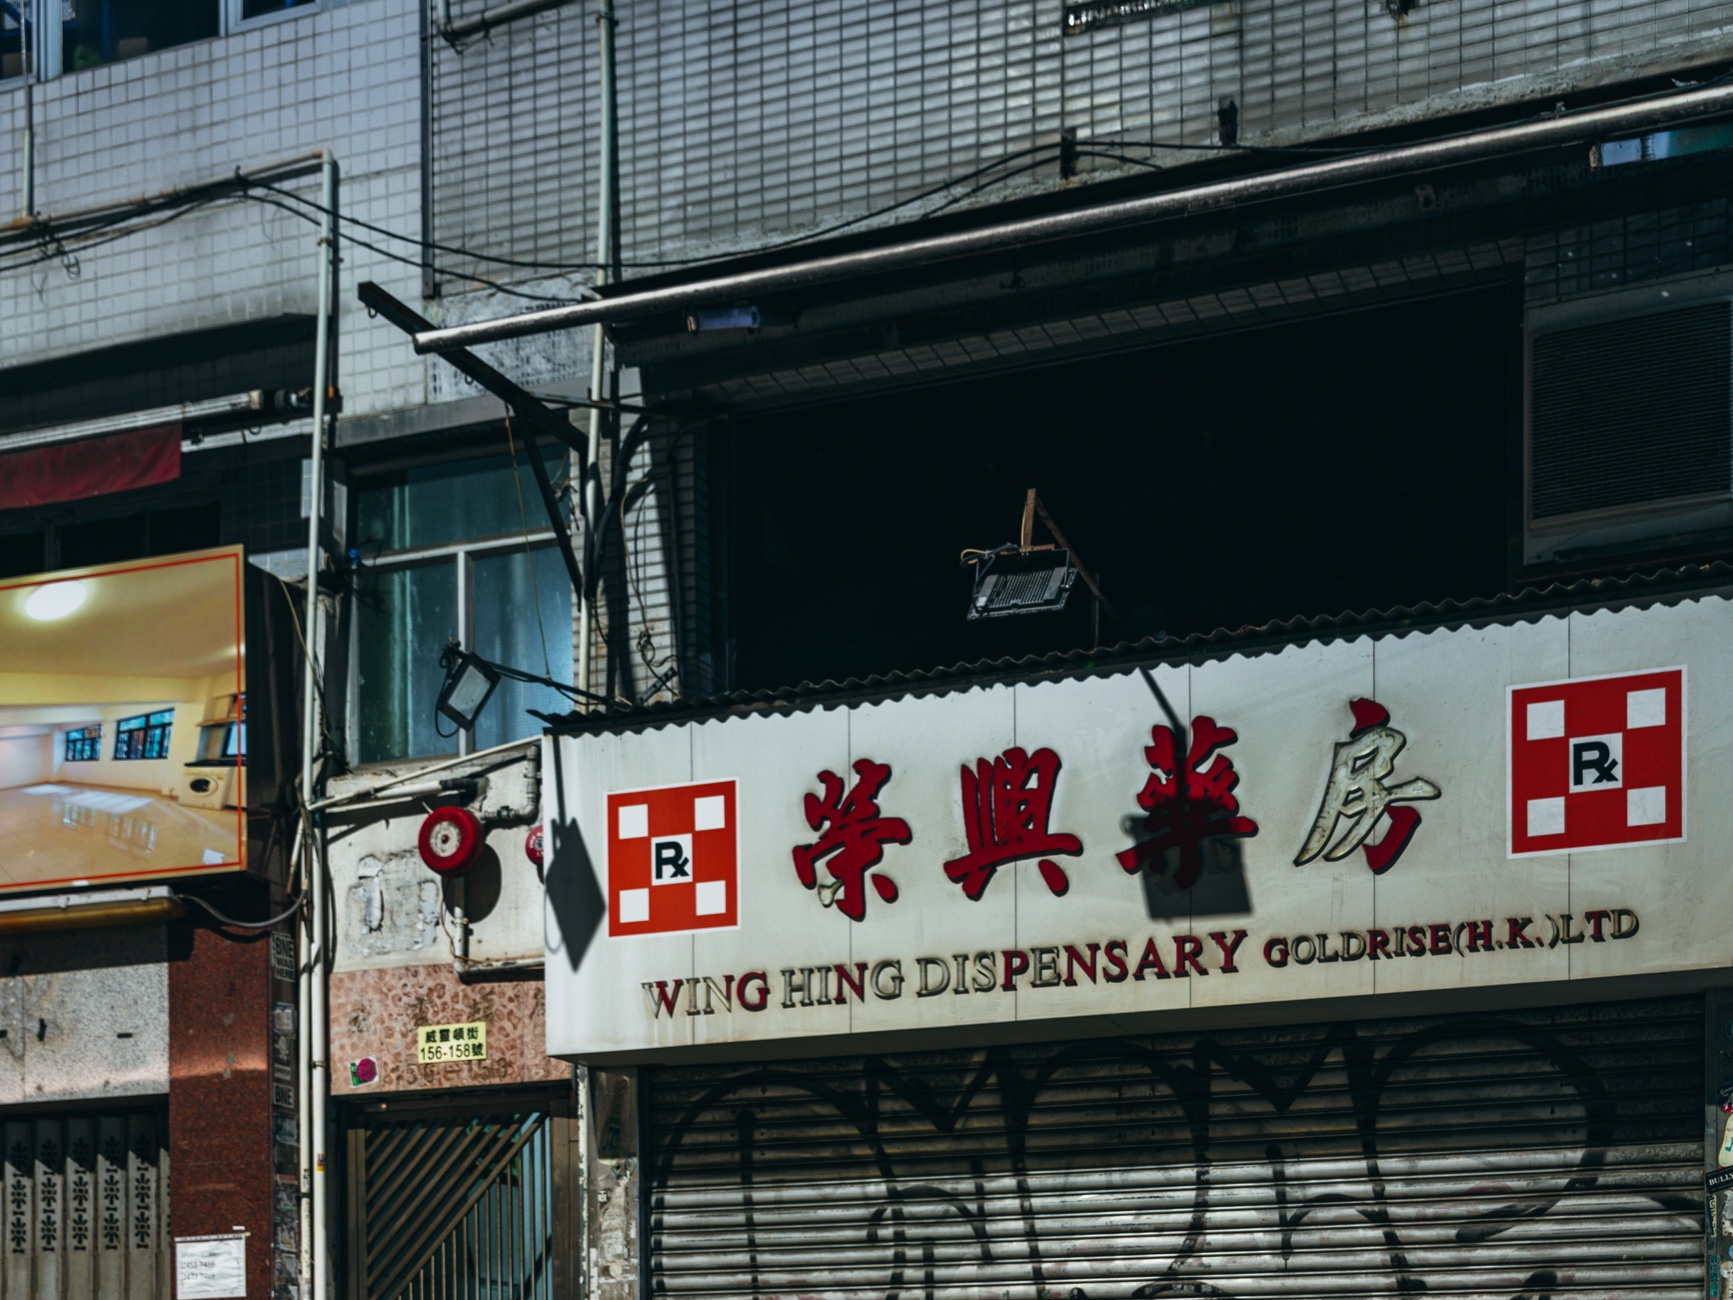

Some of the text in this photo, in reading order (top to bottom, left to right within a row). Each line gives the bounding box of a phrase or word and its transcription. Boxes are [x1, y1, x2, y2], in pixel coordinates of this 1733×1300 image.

[640, 970, 771, 1019] WING
[780, 959, 905, 1009] HING
[915, 929, 1249, 998] DISPENSARY
[275, 1085, 292, 1105] BNE
